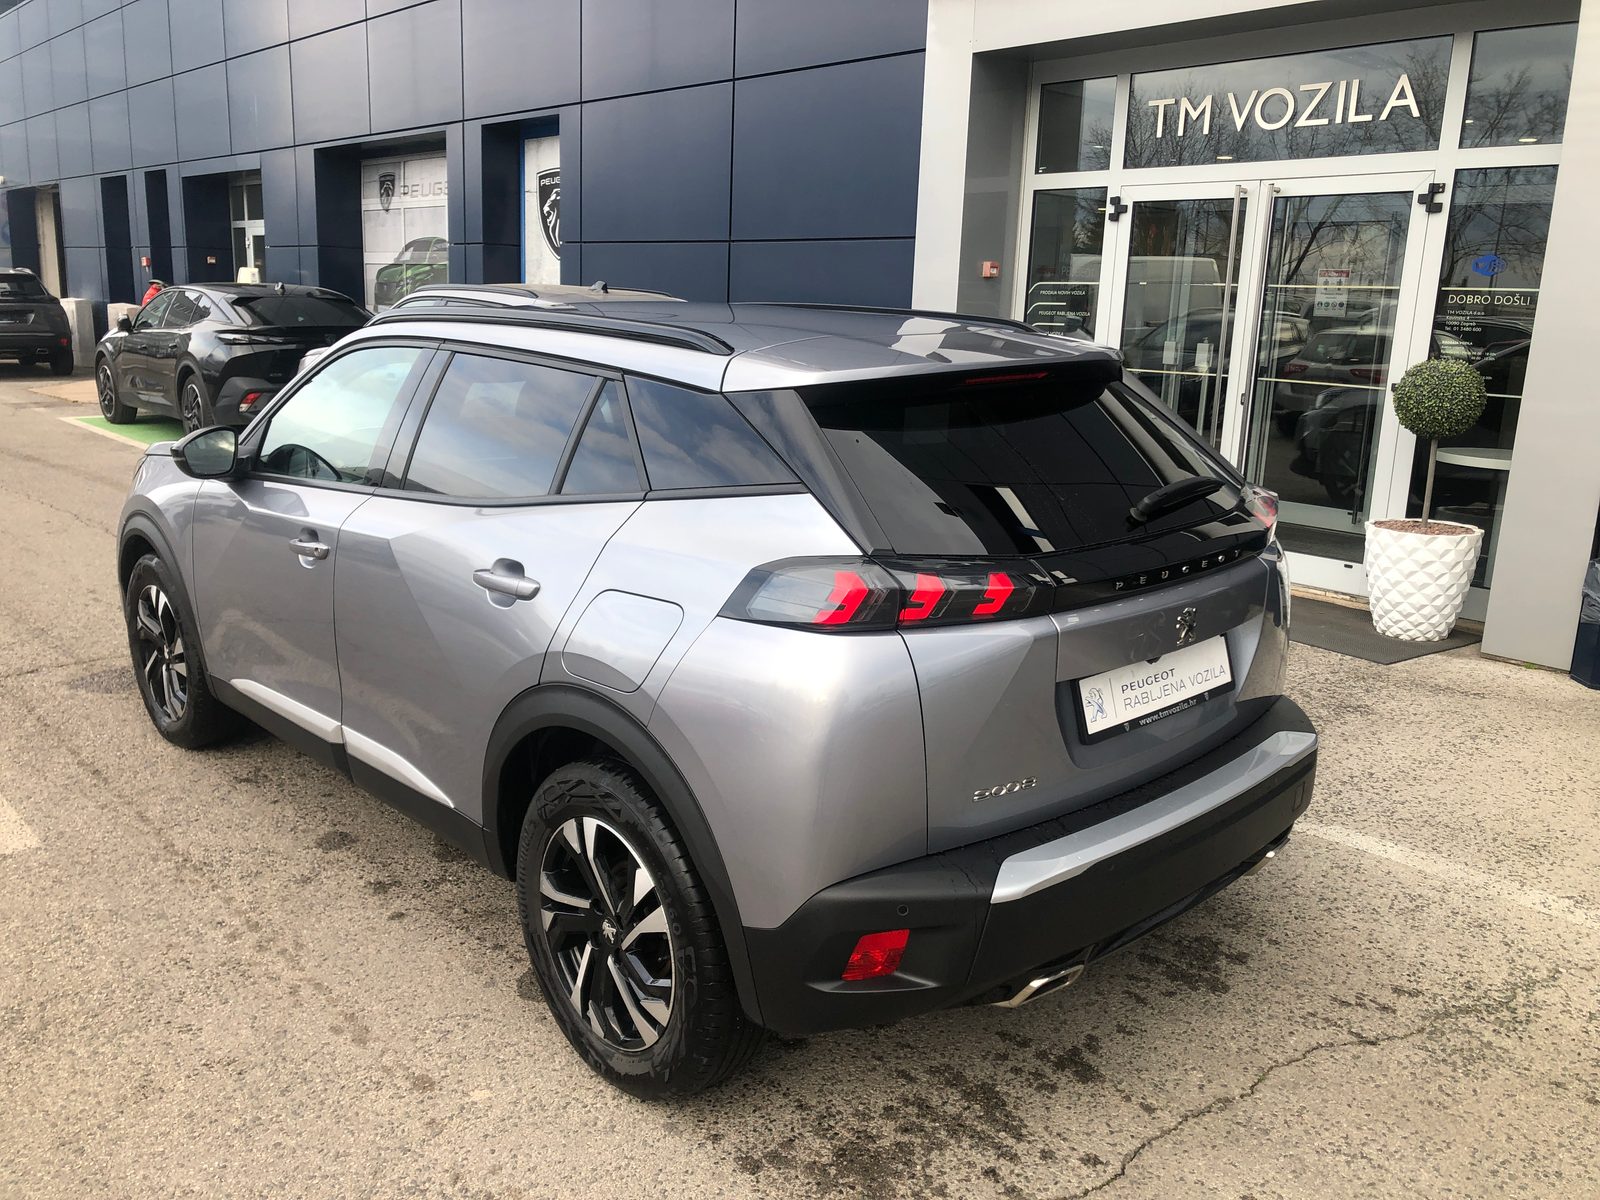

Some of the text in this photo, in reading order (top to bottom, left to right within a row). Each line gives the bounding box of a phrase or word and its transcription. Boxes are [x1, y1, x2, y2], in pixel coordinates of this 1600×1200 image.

[1148, 73, 1421, 139] TM VOZILA
[1448, 293, 1531, 306] DOBRO DOŠLI
[1115, 550, 1240, 590] PEUGEOT
[1121, 667, 1175, 694] PEUGEOT
[1123, 664, 1226, 711] RABLJENA VOZILA
[1138, 700, 1197, 726] www.tmvozila.hr
[973, 776, 1036, 802] 2008
